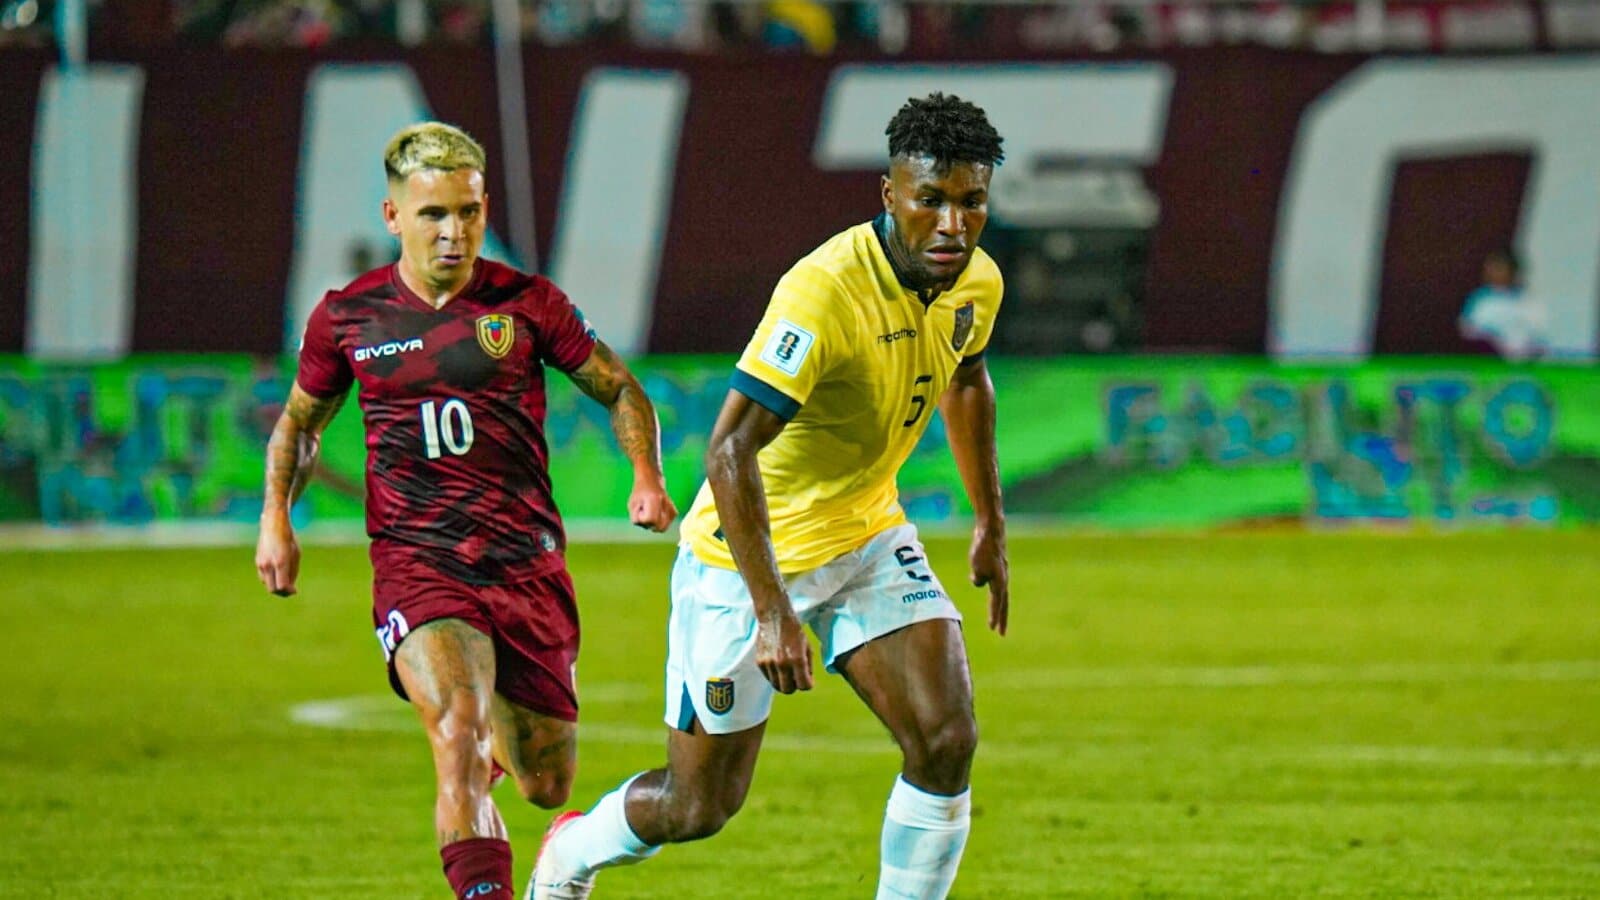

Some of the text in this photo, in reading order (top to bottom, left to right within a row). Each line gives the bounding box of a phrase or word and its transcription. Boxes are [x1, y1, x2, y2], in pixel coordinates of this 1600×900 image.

[354, 338, 423, 362] GIVOVA
[903, 374, 933, 428] 5
[420, 399, 475, 459] 10
